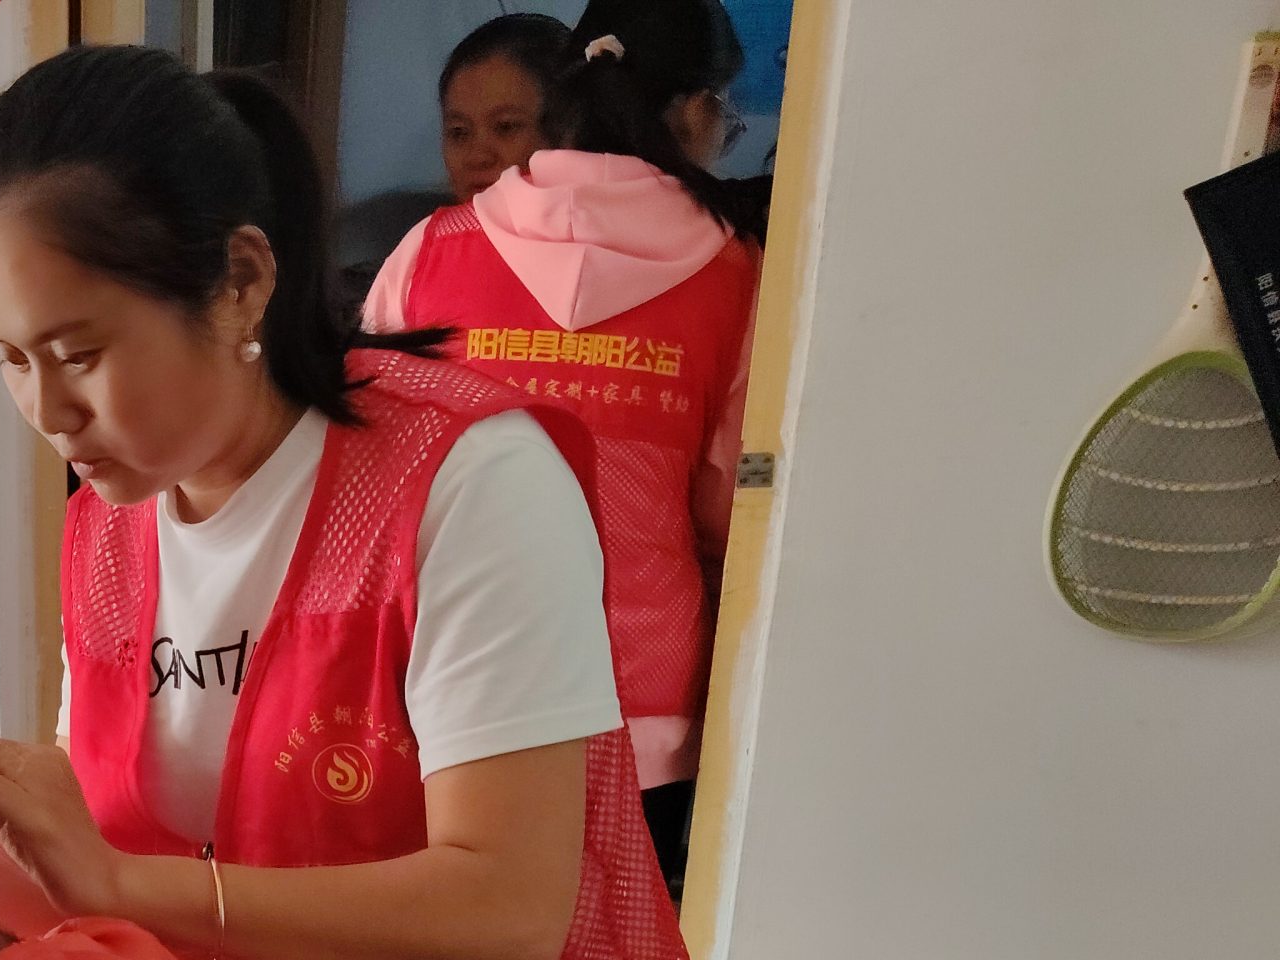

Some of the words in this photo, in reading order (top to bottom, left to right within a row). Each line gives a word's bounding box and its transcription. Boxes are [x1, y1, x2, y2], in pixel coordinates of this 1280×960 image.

[466, 327, 685, 378] 阳信县朝阳公益
[149, 629, 258, 698] SANTI
